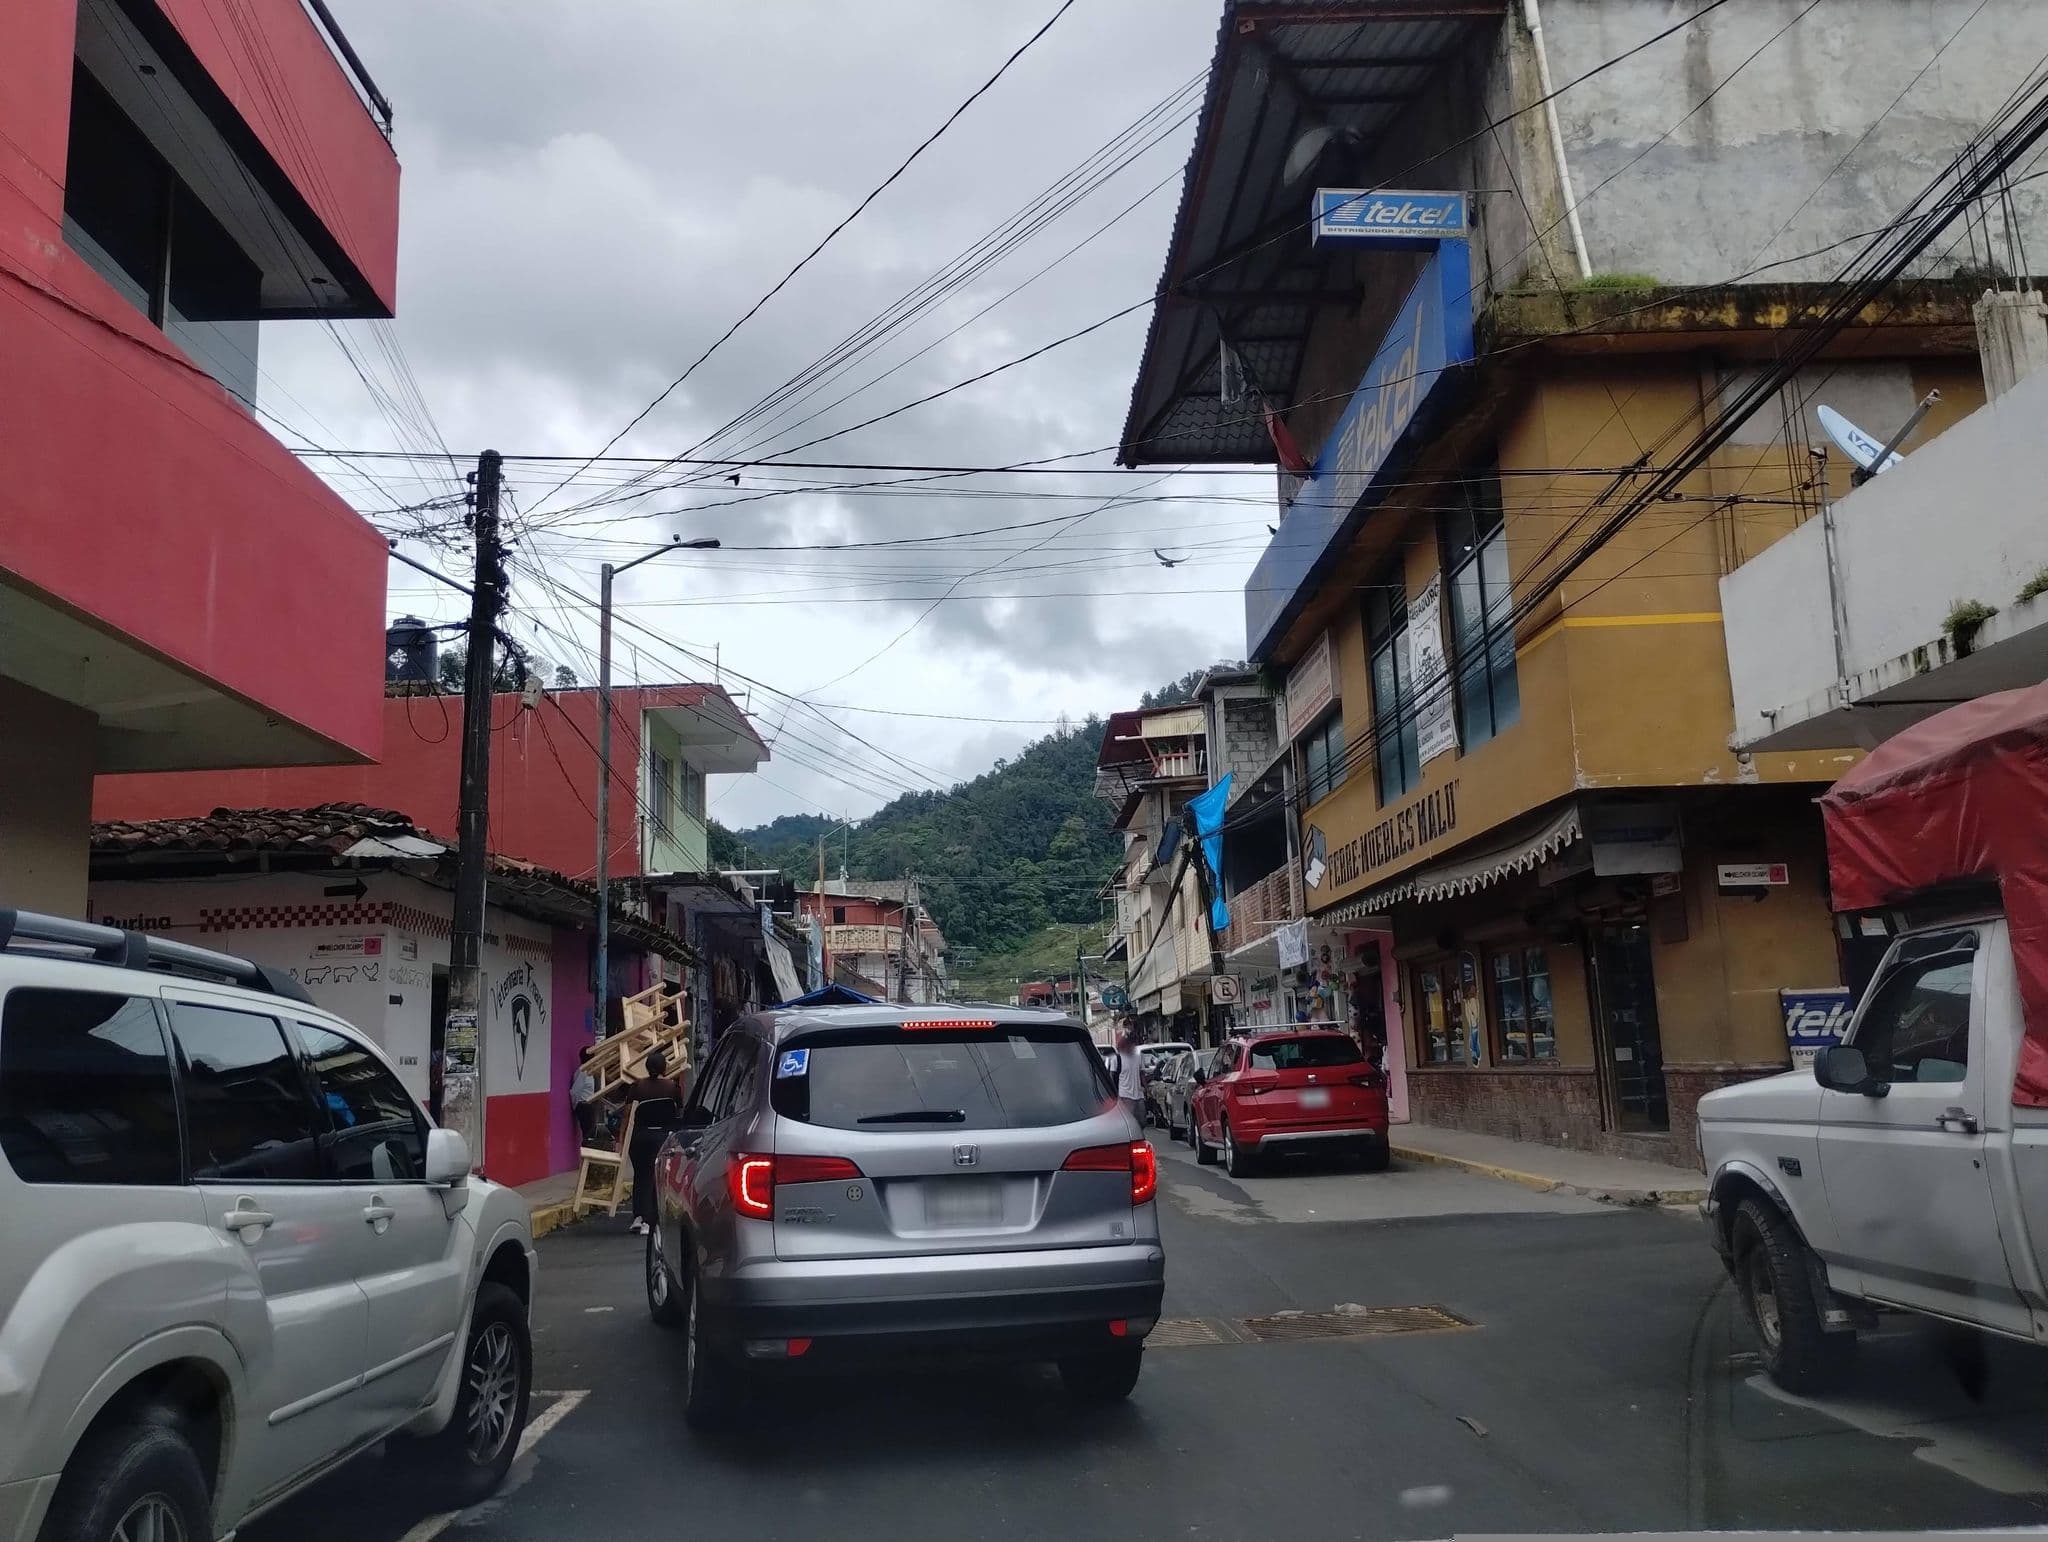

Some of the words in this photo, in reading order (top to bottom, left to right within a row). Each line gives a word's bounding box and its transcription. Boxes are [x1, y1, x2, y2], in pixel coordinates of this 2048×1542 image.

[1363, 200, 1456, 225] telcel
[1355, 300, 1424, 480] telcel
[102, 913, 171, 931] Purina
[1785, 1002, 1854, 1037] telc
